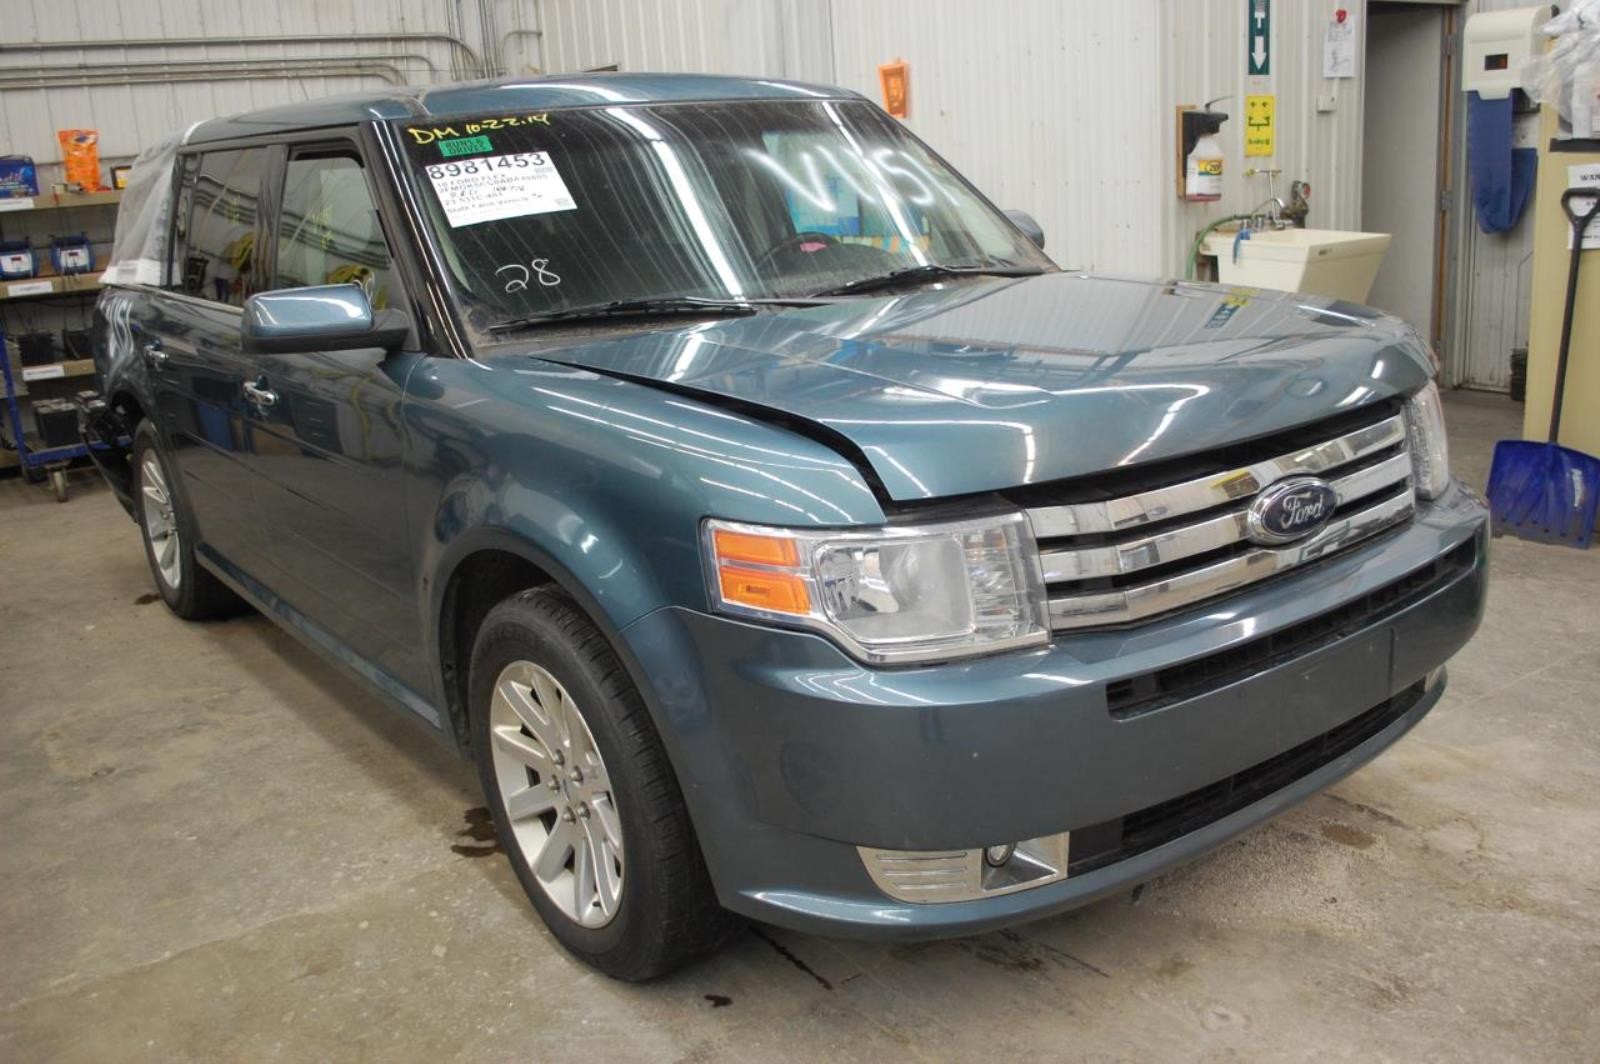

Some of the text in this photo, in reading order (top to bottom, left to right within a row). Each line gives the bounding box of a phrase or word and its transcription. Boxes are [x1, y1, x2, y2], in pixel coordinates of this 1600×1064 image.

[408, 127, 460, 145] DM
[429, 154, 545, 180] 8981453
[494, 258, 561, 293] 28
[1281, 491, 1324, 529] Ford
